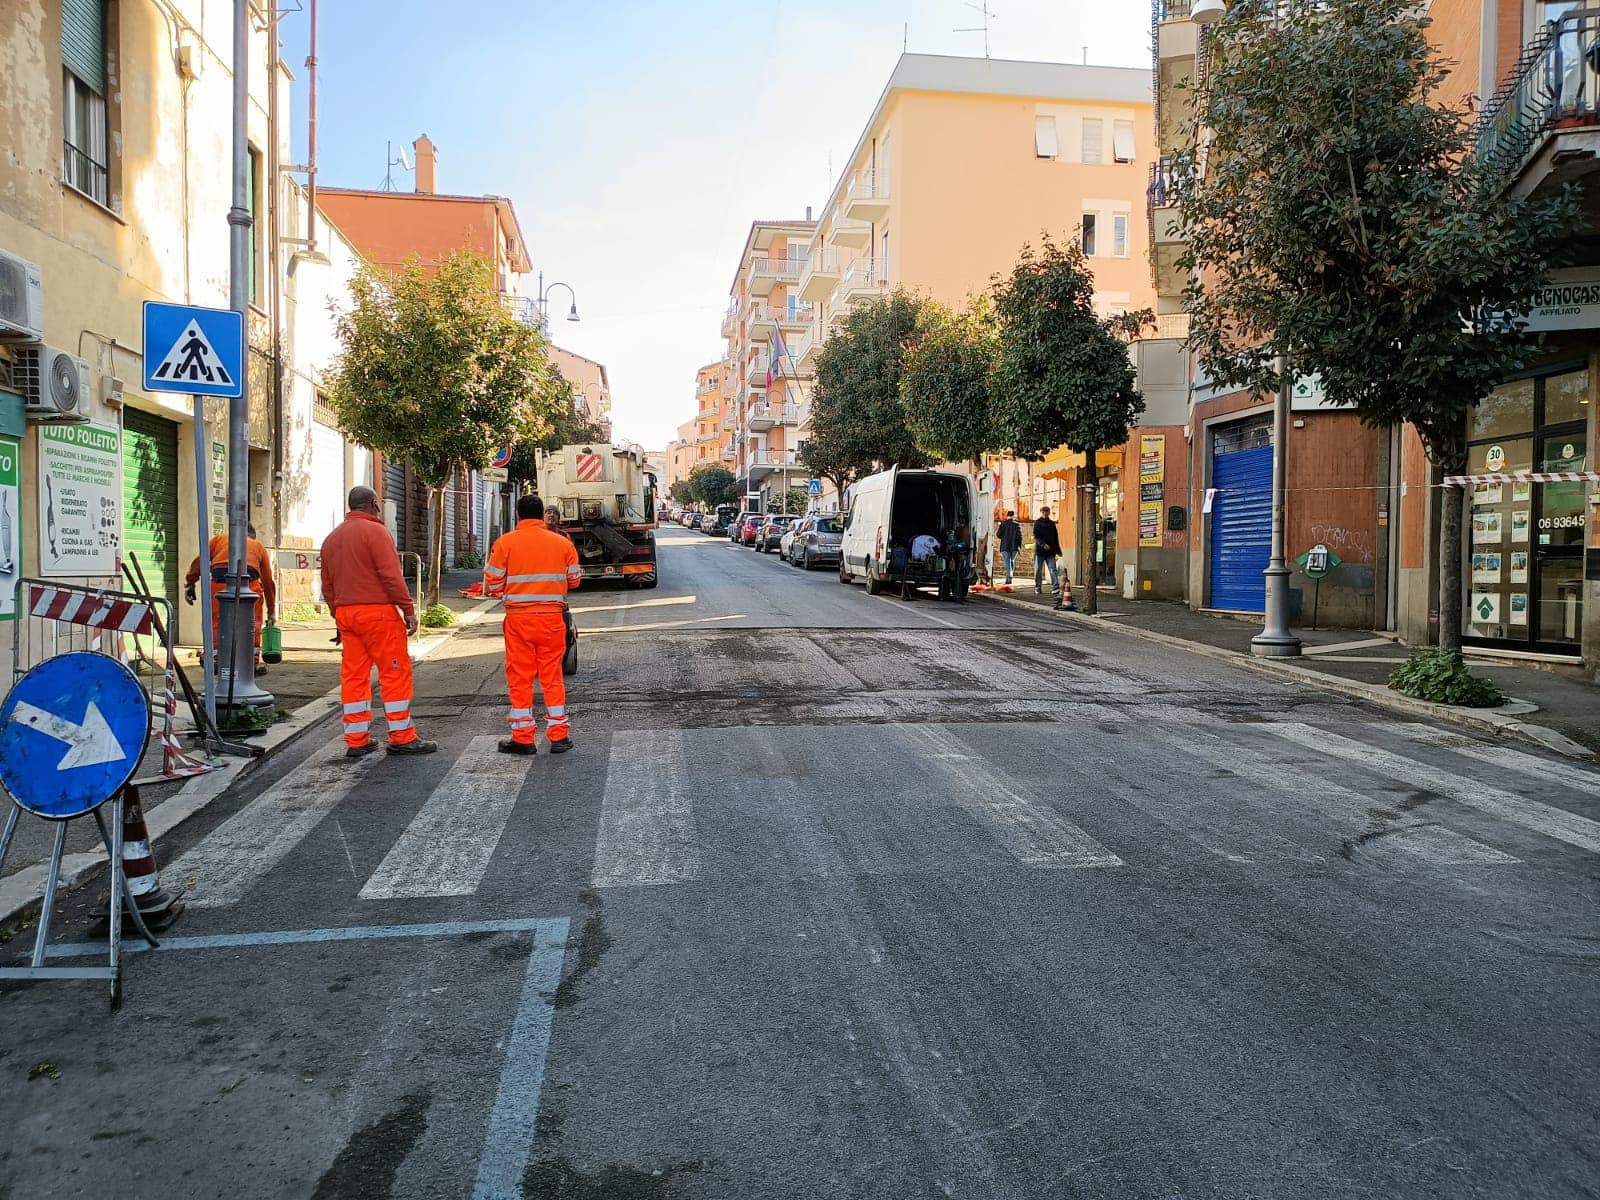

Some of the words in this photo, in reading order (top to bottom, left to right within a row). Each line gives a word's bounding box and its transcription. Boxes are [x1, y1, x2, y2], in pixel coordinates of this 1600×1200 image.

[1540, 307, 1580, 316] AFFILIATO
[45, 425, 75, 441] TUTTO
[77, 429, 117, 450] FOLLETTO
[1490, 449, 1501, 460] 30
[1539, 518, 1551, 529] 06
[1553, 515, 1585, 528] 93645
